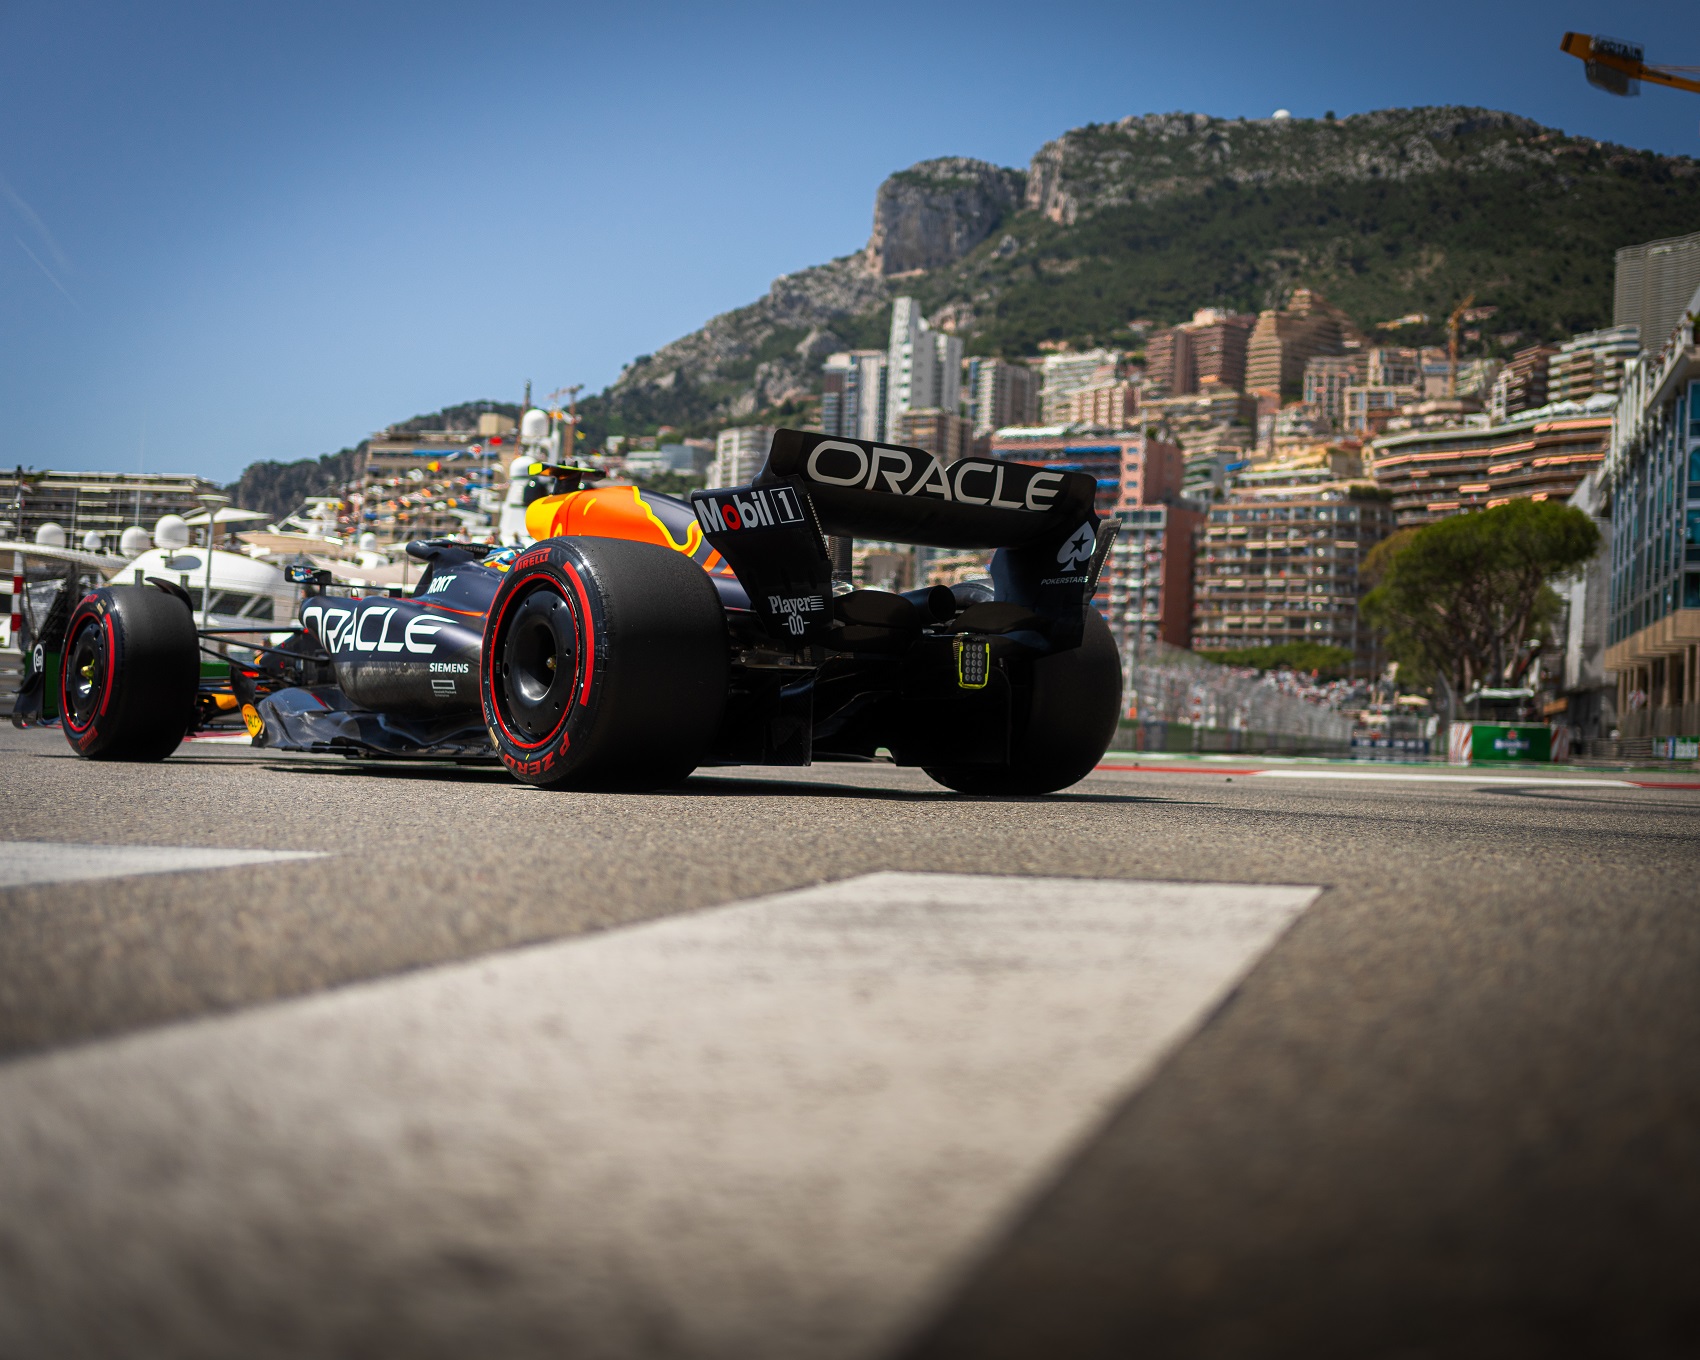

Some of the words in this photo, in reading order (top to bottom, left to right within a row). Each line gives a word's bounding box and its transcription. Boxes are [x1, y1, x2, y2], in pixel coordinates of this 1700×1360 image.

[806, 439, 1065, 511] ORACLE
[694, 490, 775, 534] Mobil
[777, 490, 795, 520] 1
[514, 547, 552, 573] PIRELLI
[1041, 576, 1089, 585] POKERSTARS
[429, 662, 469, 673] SIEMENS
[559, 731, 571, 757] P
[503, 751, 555, 776] ZERO
